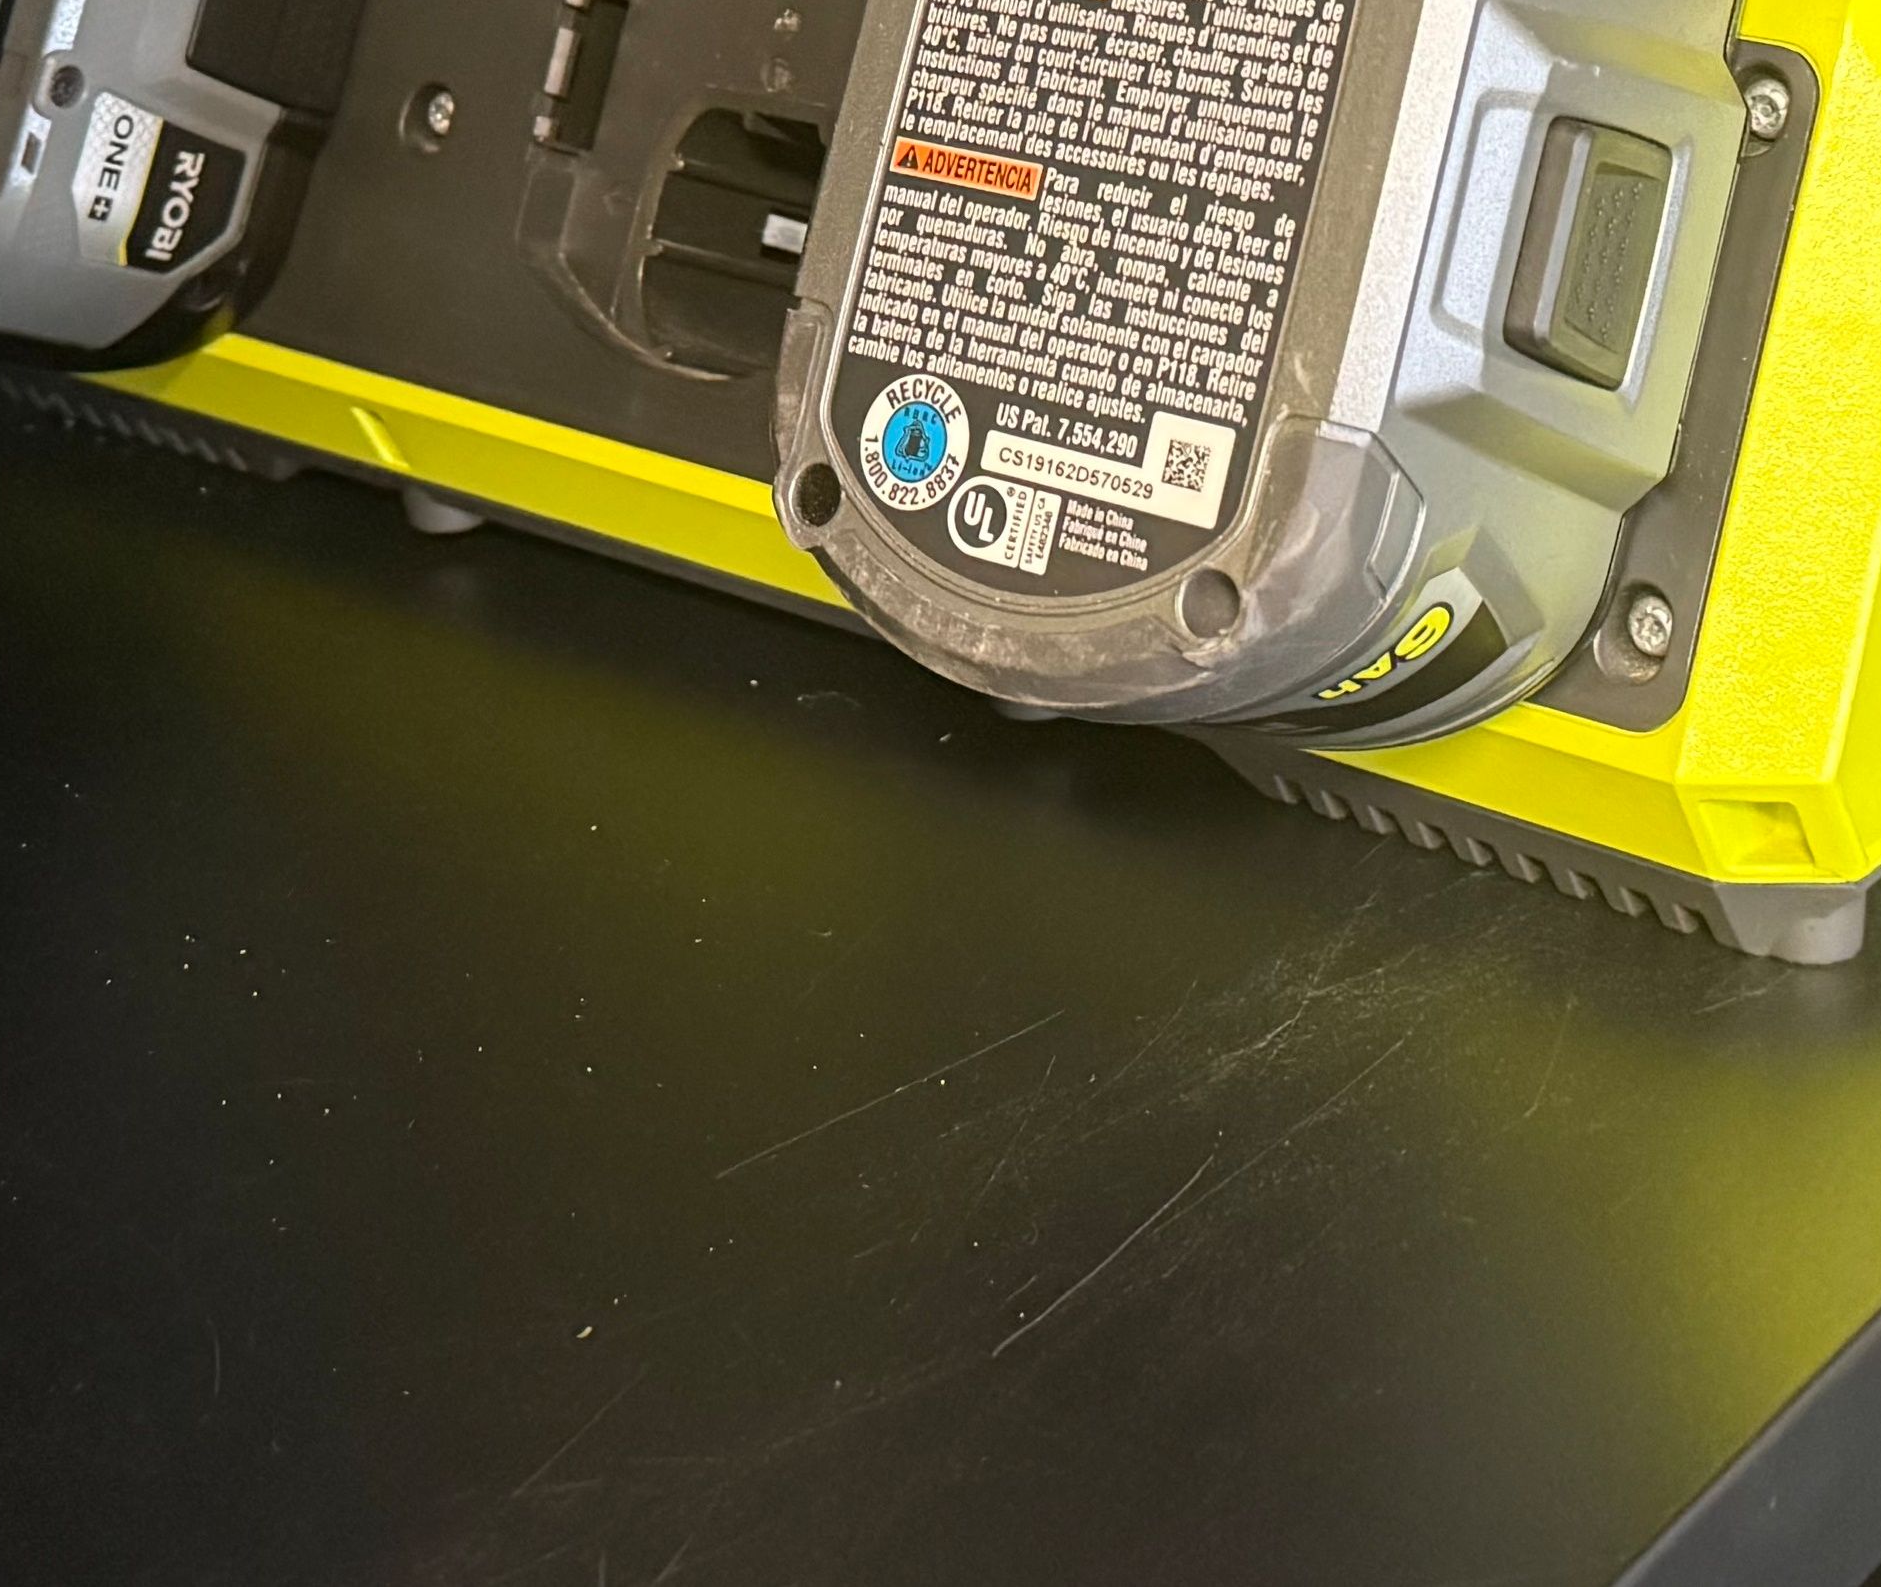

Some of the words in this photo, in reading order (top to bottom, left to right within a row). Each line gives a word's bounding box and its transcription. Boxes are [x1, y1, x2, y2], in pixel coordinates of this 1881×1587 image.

[1306, 20, 1340, 45] doit
[901, 109, 915, 130] le
[918, 117, 1025, 152] remplacement
[1025, 133, 1053, 157] des
[1055, 143, 1146, 176] accessoires
[1149, 161, 1169, 180] ou
[1173, 160, 1197, 186] les
[906, 87, 948, 114] P118.
[952, 96, 1004, 124] Retirer
[1007, 106, 1022, 129] la
[1024, 111, 1055, 137] pile
[1059, 116, 1078, 139] de
[1130, 134, 1196, 164] pendant
[88, 114, 135, 222] ONE+
[922, 148, 1033, 193] ADVERTENCIA
[145, 151, 206, 262] RYOBI
[1039, 190, 1106, 227] lesiones,
[1112, 206, 1128, 227] el
[1131, 213, 1189, 240] usuario
[1193, 222, 1235, 249] debe
[1237, 229, 1270, 256] leer
[1273, 238, 1291, 261] el
[1044, 167, 1079, 194] Para
[1097, 182, 1152, 208] reducir
[1170, 194, 1187, 215] el
[1202, 200, 1255, 233] riesgo
[1274, 214, 1295, 238] de
[848, 336, 899, 362] cambie
[902, 344, 924, 369] los
[927, 353, 1017, 391] aditamentos
[1019, 377, 1029, 395] o
[1031, 380, 1084, 408] realice
[1086, 391, 1145, 423] ajustes.
[886, 377, 962, 424] RECYCLE
[996, 403, 1019, 428] US
[1022, 409, 1050, 437] Pat.
[1058, 418, 1137, 458] 7,554,290
[998, 447, 1154, 500] CS19162D570529
[963, 490, 995, 543] UL
[1004, 490, 1027, 561] CERTIFIED
[1066, 499, 1094, 517] Made
[1093, 505, 1105, 520] in
[1105, 509, 1134, 531] China
[1118, 530, 1148, 554] Chine
[1058, 532, 1106, 561] Fabricado
[1119, 549, 1149, 572] China
[1316, 604, 1453, 700] 6Ah
